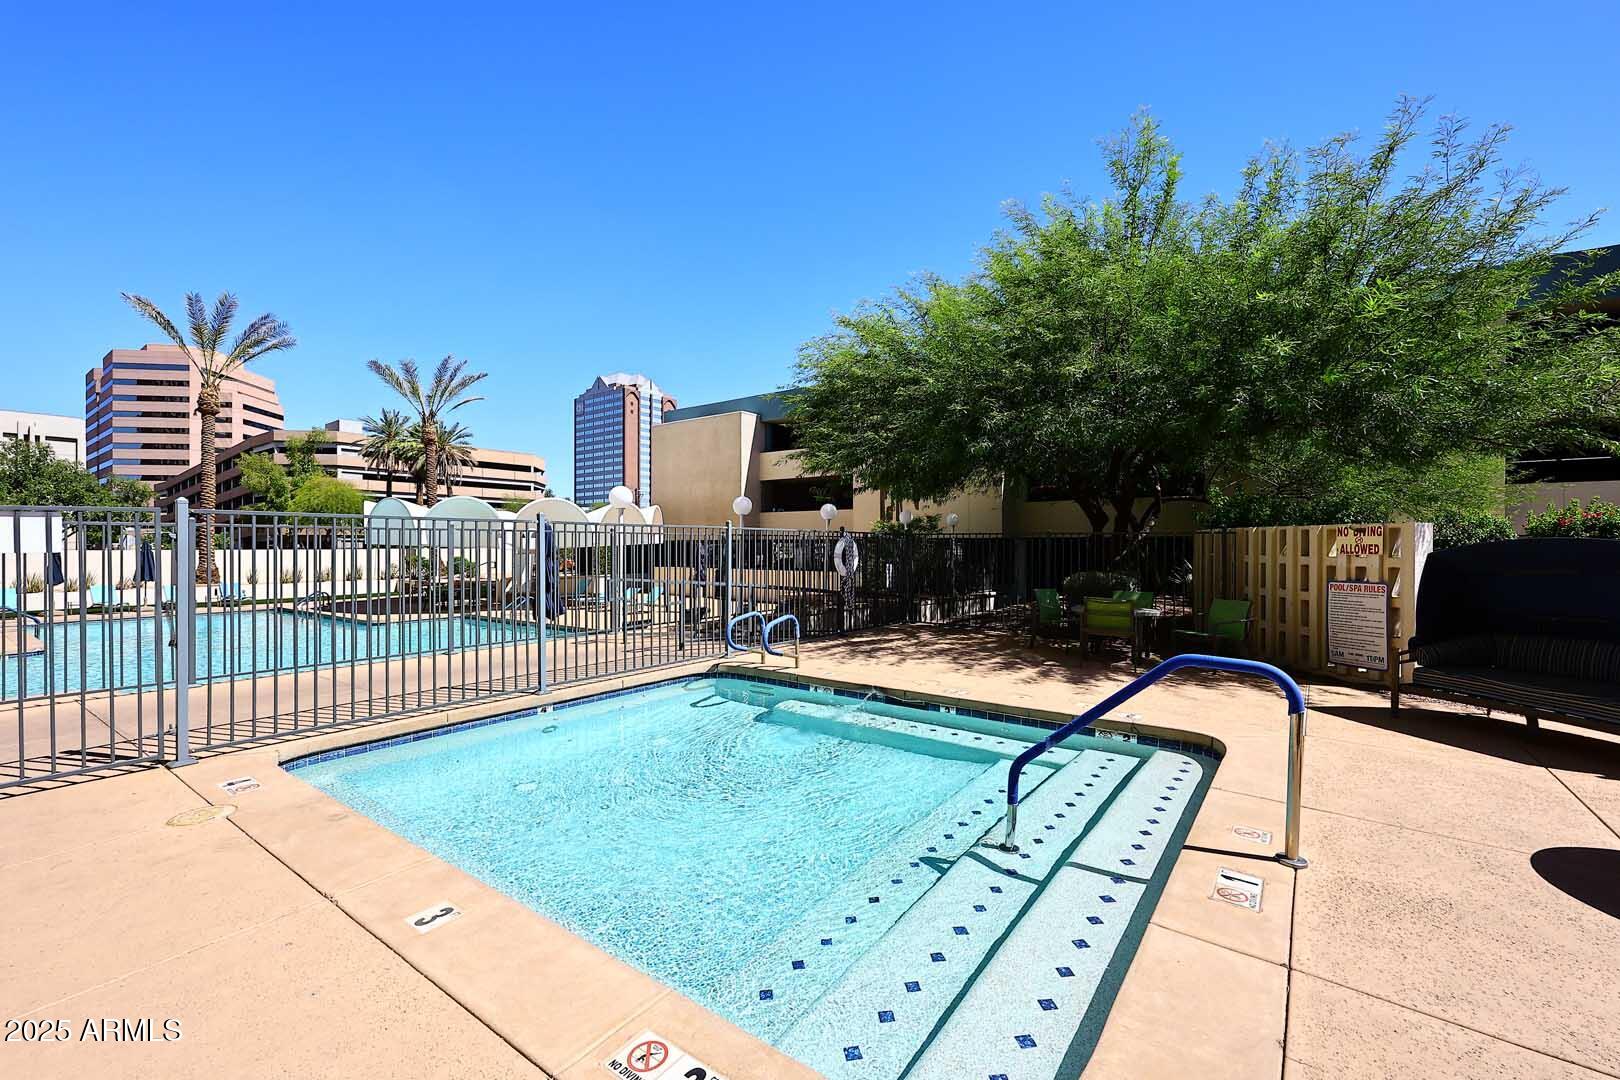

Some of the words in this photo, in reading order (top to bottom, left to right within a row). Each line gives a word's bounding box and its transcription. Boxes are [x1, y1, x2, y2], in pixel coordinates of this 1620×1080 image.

[1337, 526, 1349, 537] NO
[1340, 543, 1380, 555] ALLOWED
[1329, 583, 1362, 593] POOL/SPA
[1363, 585, 1386, 594] RULES
[608, 1058, 623, 1071] NO
